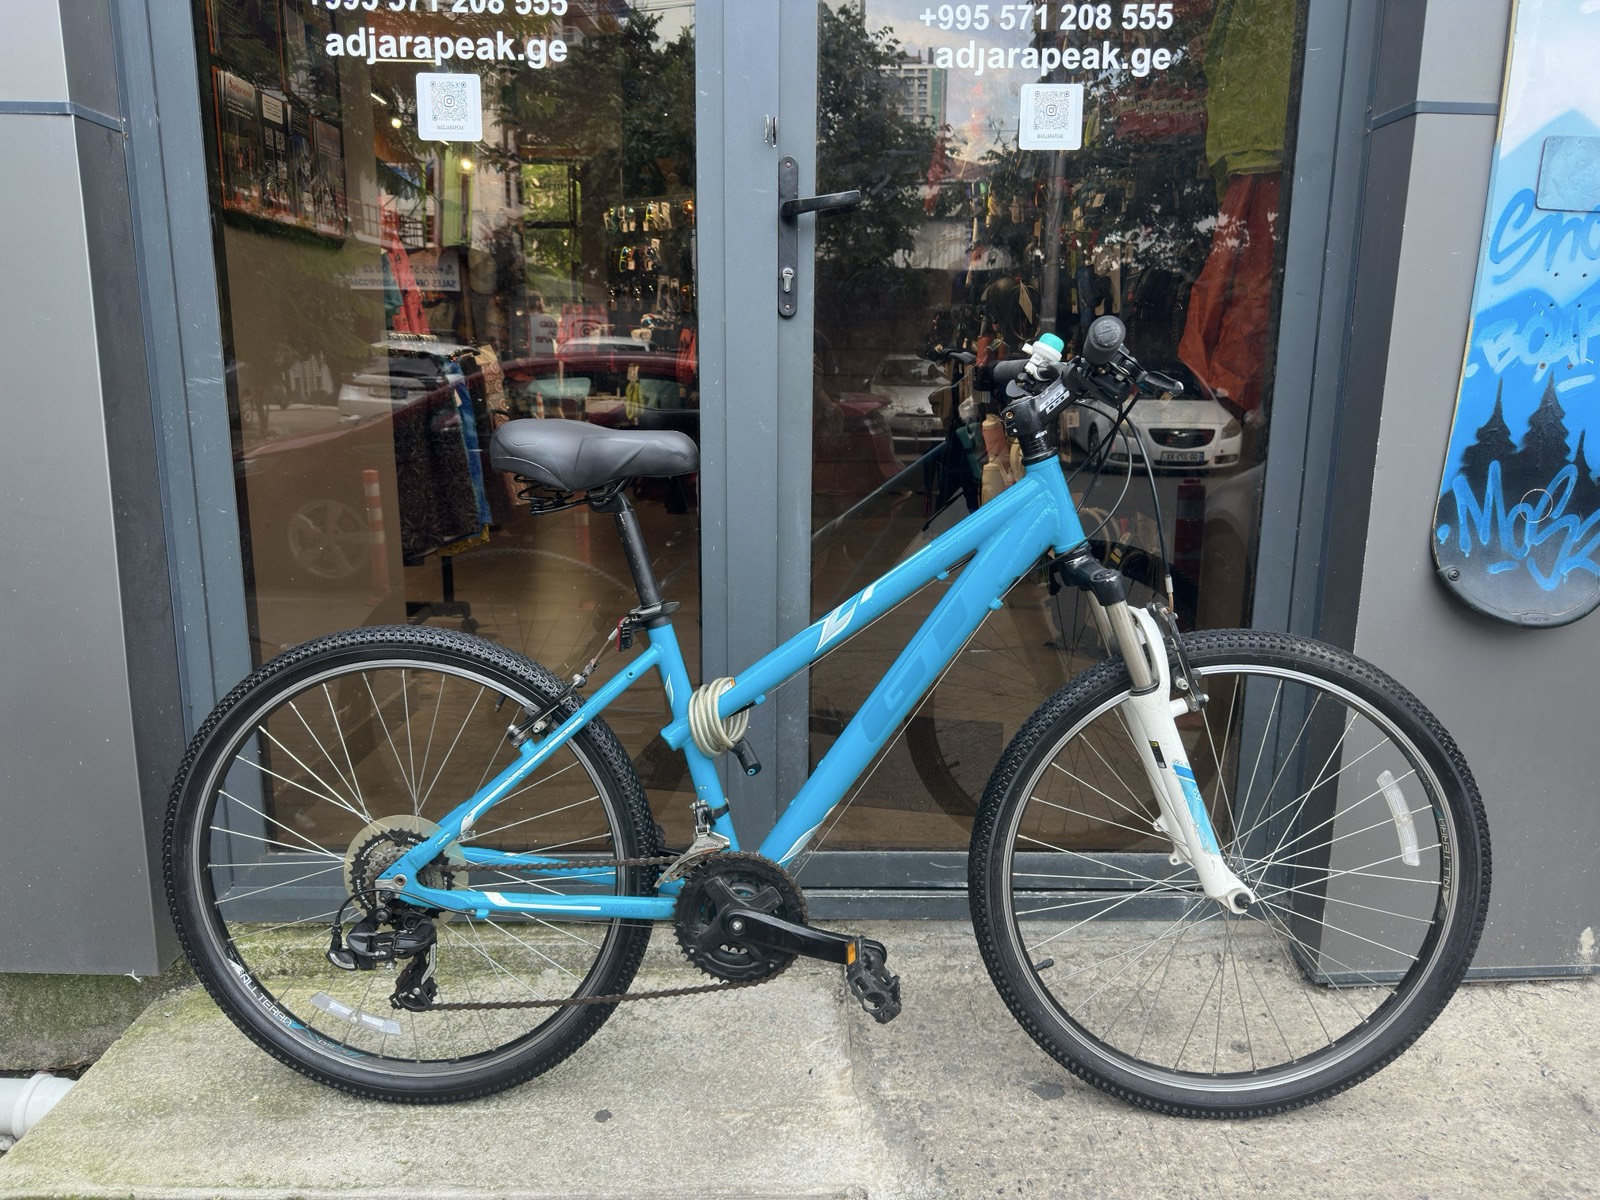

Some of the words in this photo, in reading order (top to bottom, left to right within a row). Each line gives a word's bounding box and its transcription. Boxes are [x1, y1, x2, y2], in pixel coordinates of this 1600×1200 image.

[919, 4, 989, 30] +995
[999, 4, 1048, 30] 571
[1060, 4, 1112, 30] 208
[1121, 4, 1174, 30] 555
[325, 27, 568, 69] adjarapeak.ge
[936, 40, 1171, 77] adjarapeak.ge
[258, 992, 292, 1027] TERRA
